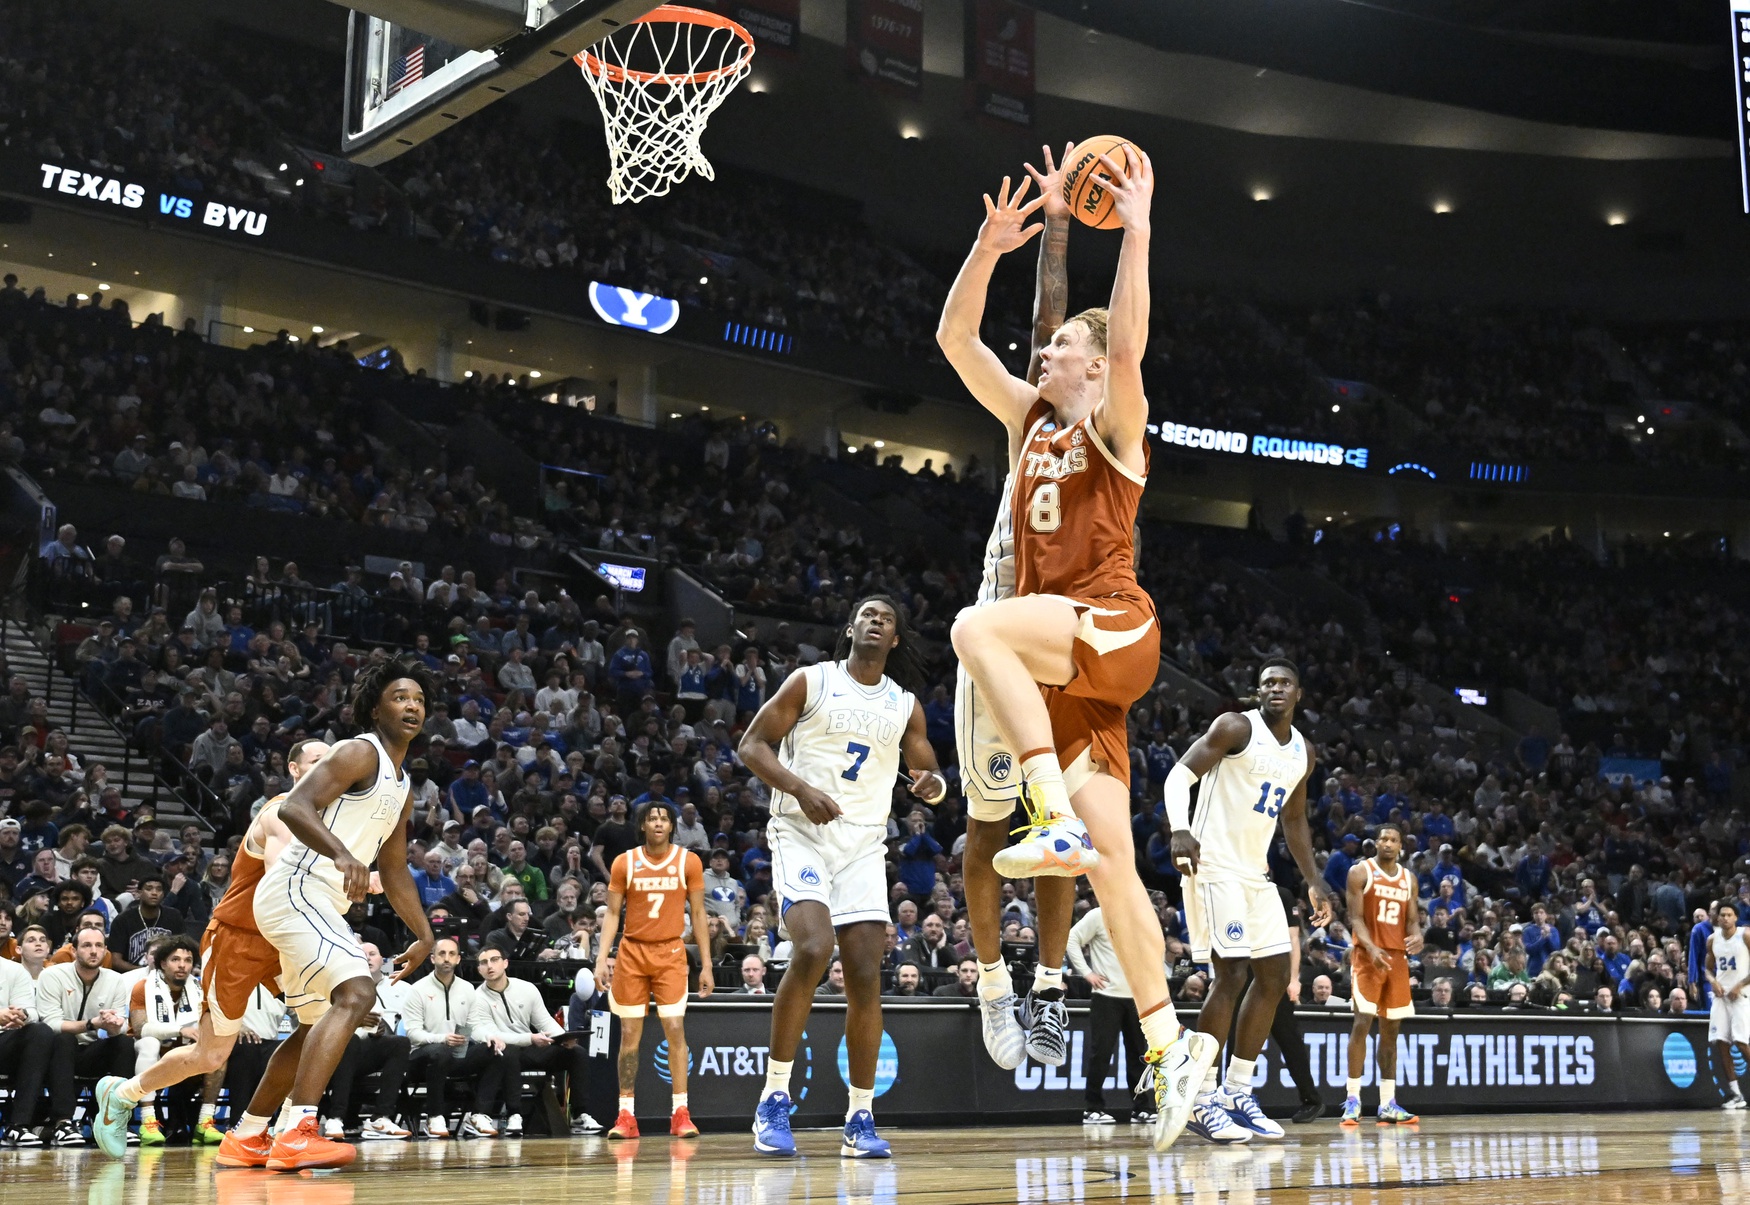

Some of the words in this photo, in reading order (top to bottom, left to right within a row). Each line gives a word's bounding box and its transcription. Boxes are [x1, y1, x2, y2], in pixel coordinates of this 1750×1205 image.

[40, 163, 145, 208] TEXAS
[159, 193, 193, 218] VS
[203, 201, 268, 236] BYU
[1161, 421, 1248, 454] SECOND
[1251, 435, 1345, 466] ROUNDS
[1029, 482, 1061, 533] 8
[826, 709, 898, 746] BYU
[840, 741, 871, 782] 7
[371, 794, 400, 826] BY
[1253, 781, 1287, 818] 13
[633, 876, 679, 891] TEXAS
[1373, 883, 1408, 902] TEXAS
[647, 892, 665, 919] 7
[1377, 899, 1401, 925] 12
[1718, 955, 1737, 971] 24
[698, 1046, 769, 1076] AT&T
[1280, 1032, 1595, 1088] TUNT-ATHLETES
